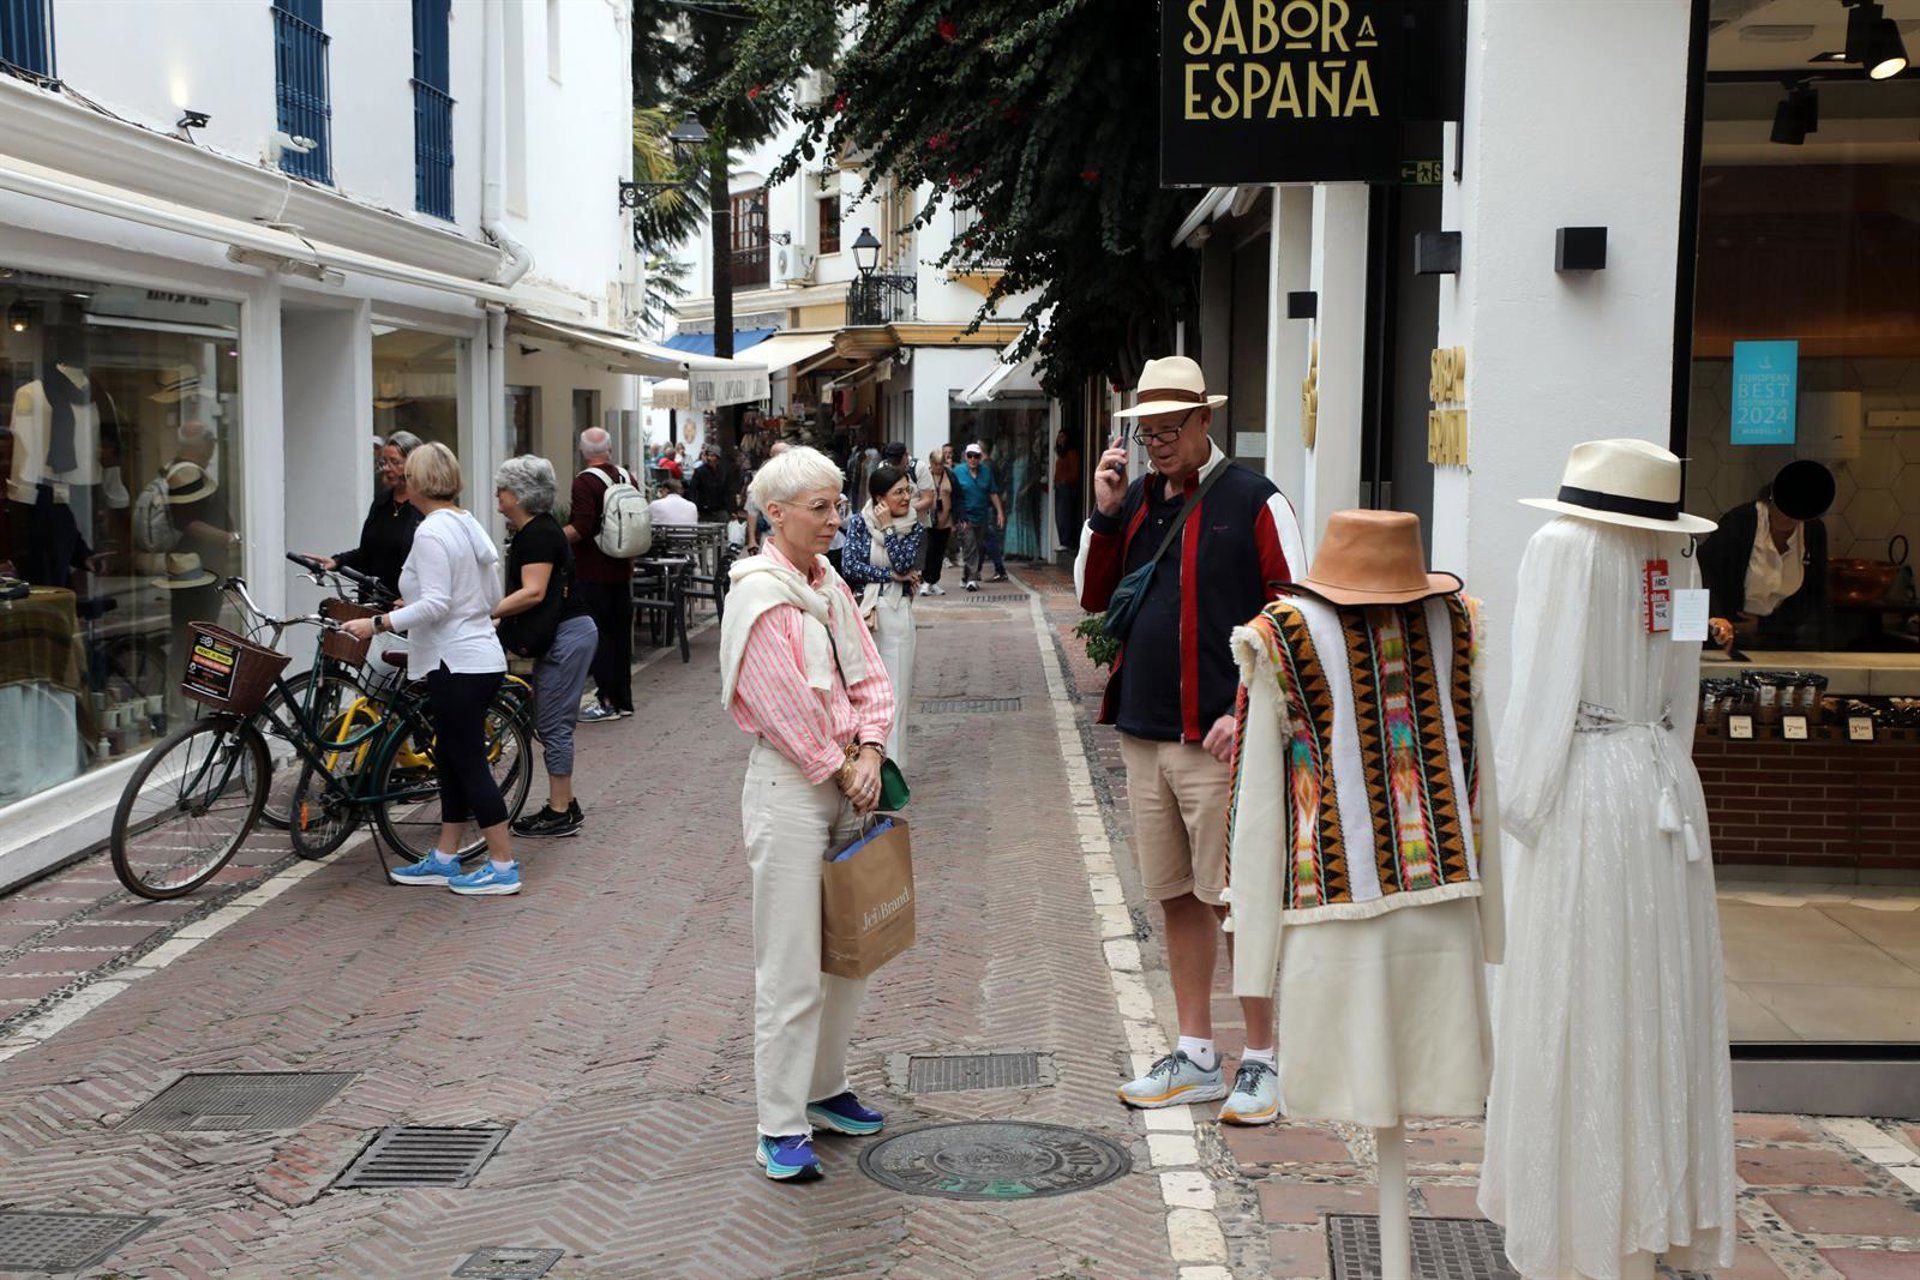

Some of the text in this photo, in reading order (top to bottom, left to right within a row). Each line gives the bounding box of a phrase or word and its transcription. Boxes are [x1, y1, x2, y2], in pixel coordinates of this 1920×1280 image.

[1183, 0, 1350, 55] SABOR
[1184, 60, 1380, 120] ESPAÑA
[1738, 383, 1789, 399] BEST
[1737, 406, 1788, 425] 2024
